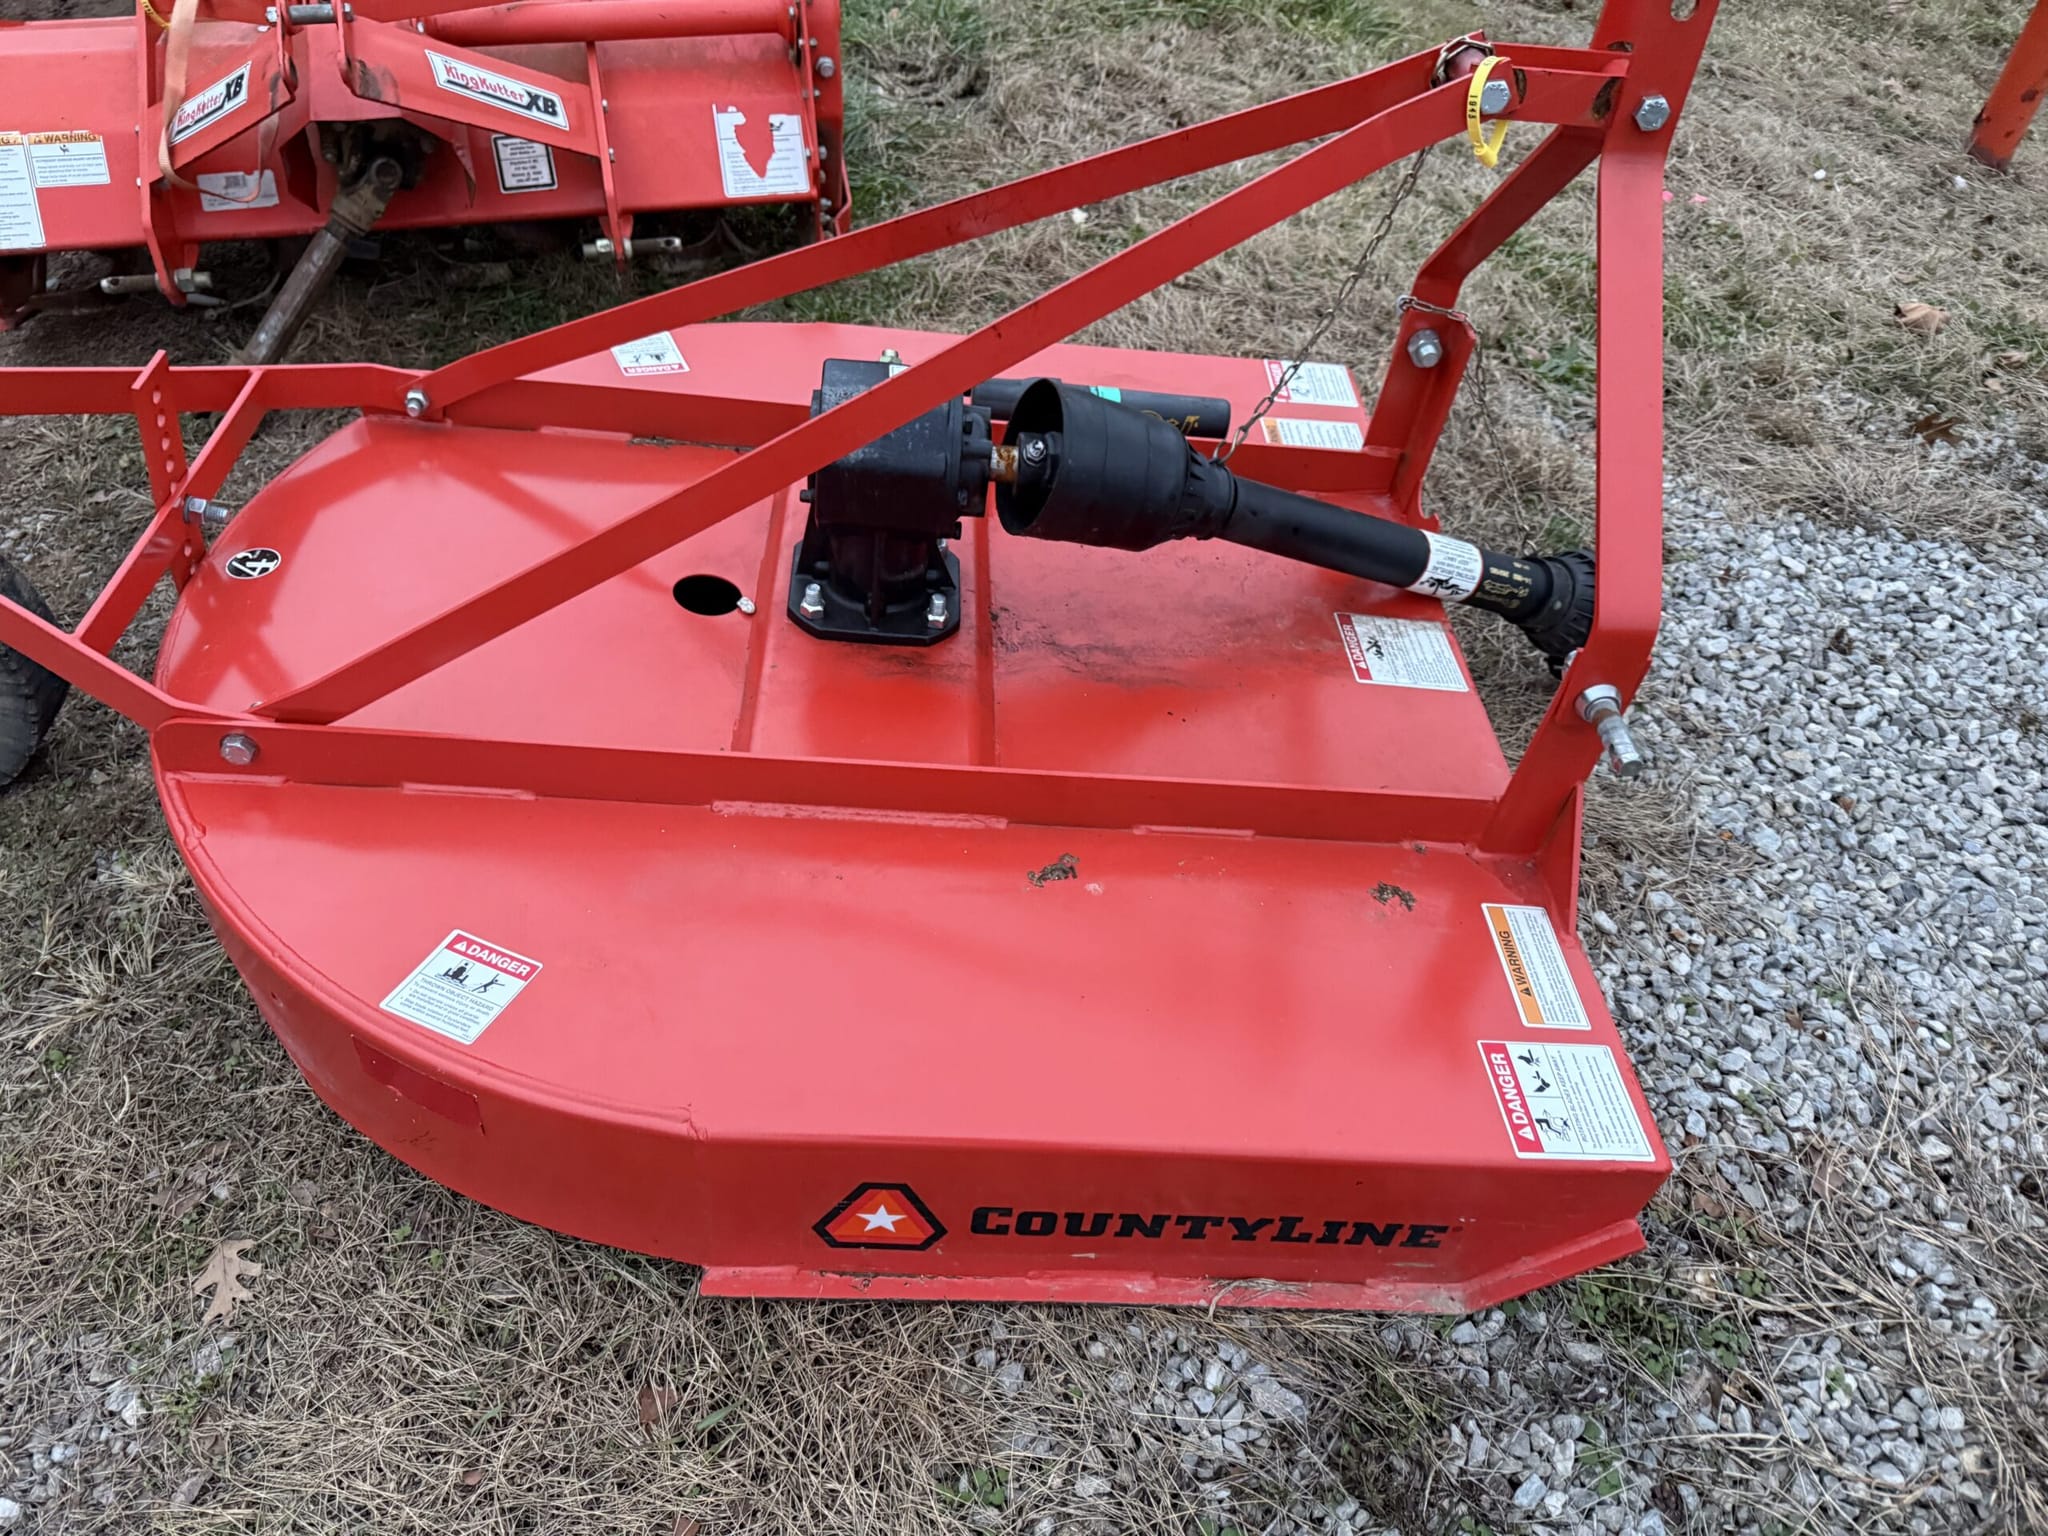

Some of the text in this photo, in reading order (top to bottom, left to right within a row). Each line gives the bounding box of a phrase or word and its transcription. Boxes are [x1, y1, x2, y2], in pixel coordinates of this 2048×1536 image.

[224, 73, 245, 102] XB
[525, 87, 558, 116] XB
[44, 133, 97, 143] WARNING
[1342, 624, 1365, 665] DANGER
[467, 946, 531, 976] DANGER
[1499, 930, 1528, 986] WARNING
[1490, 1053, 1528, 1124] DANGER
[970, 1206, 1449, 1248] COUNTYLINE
